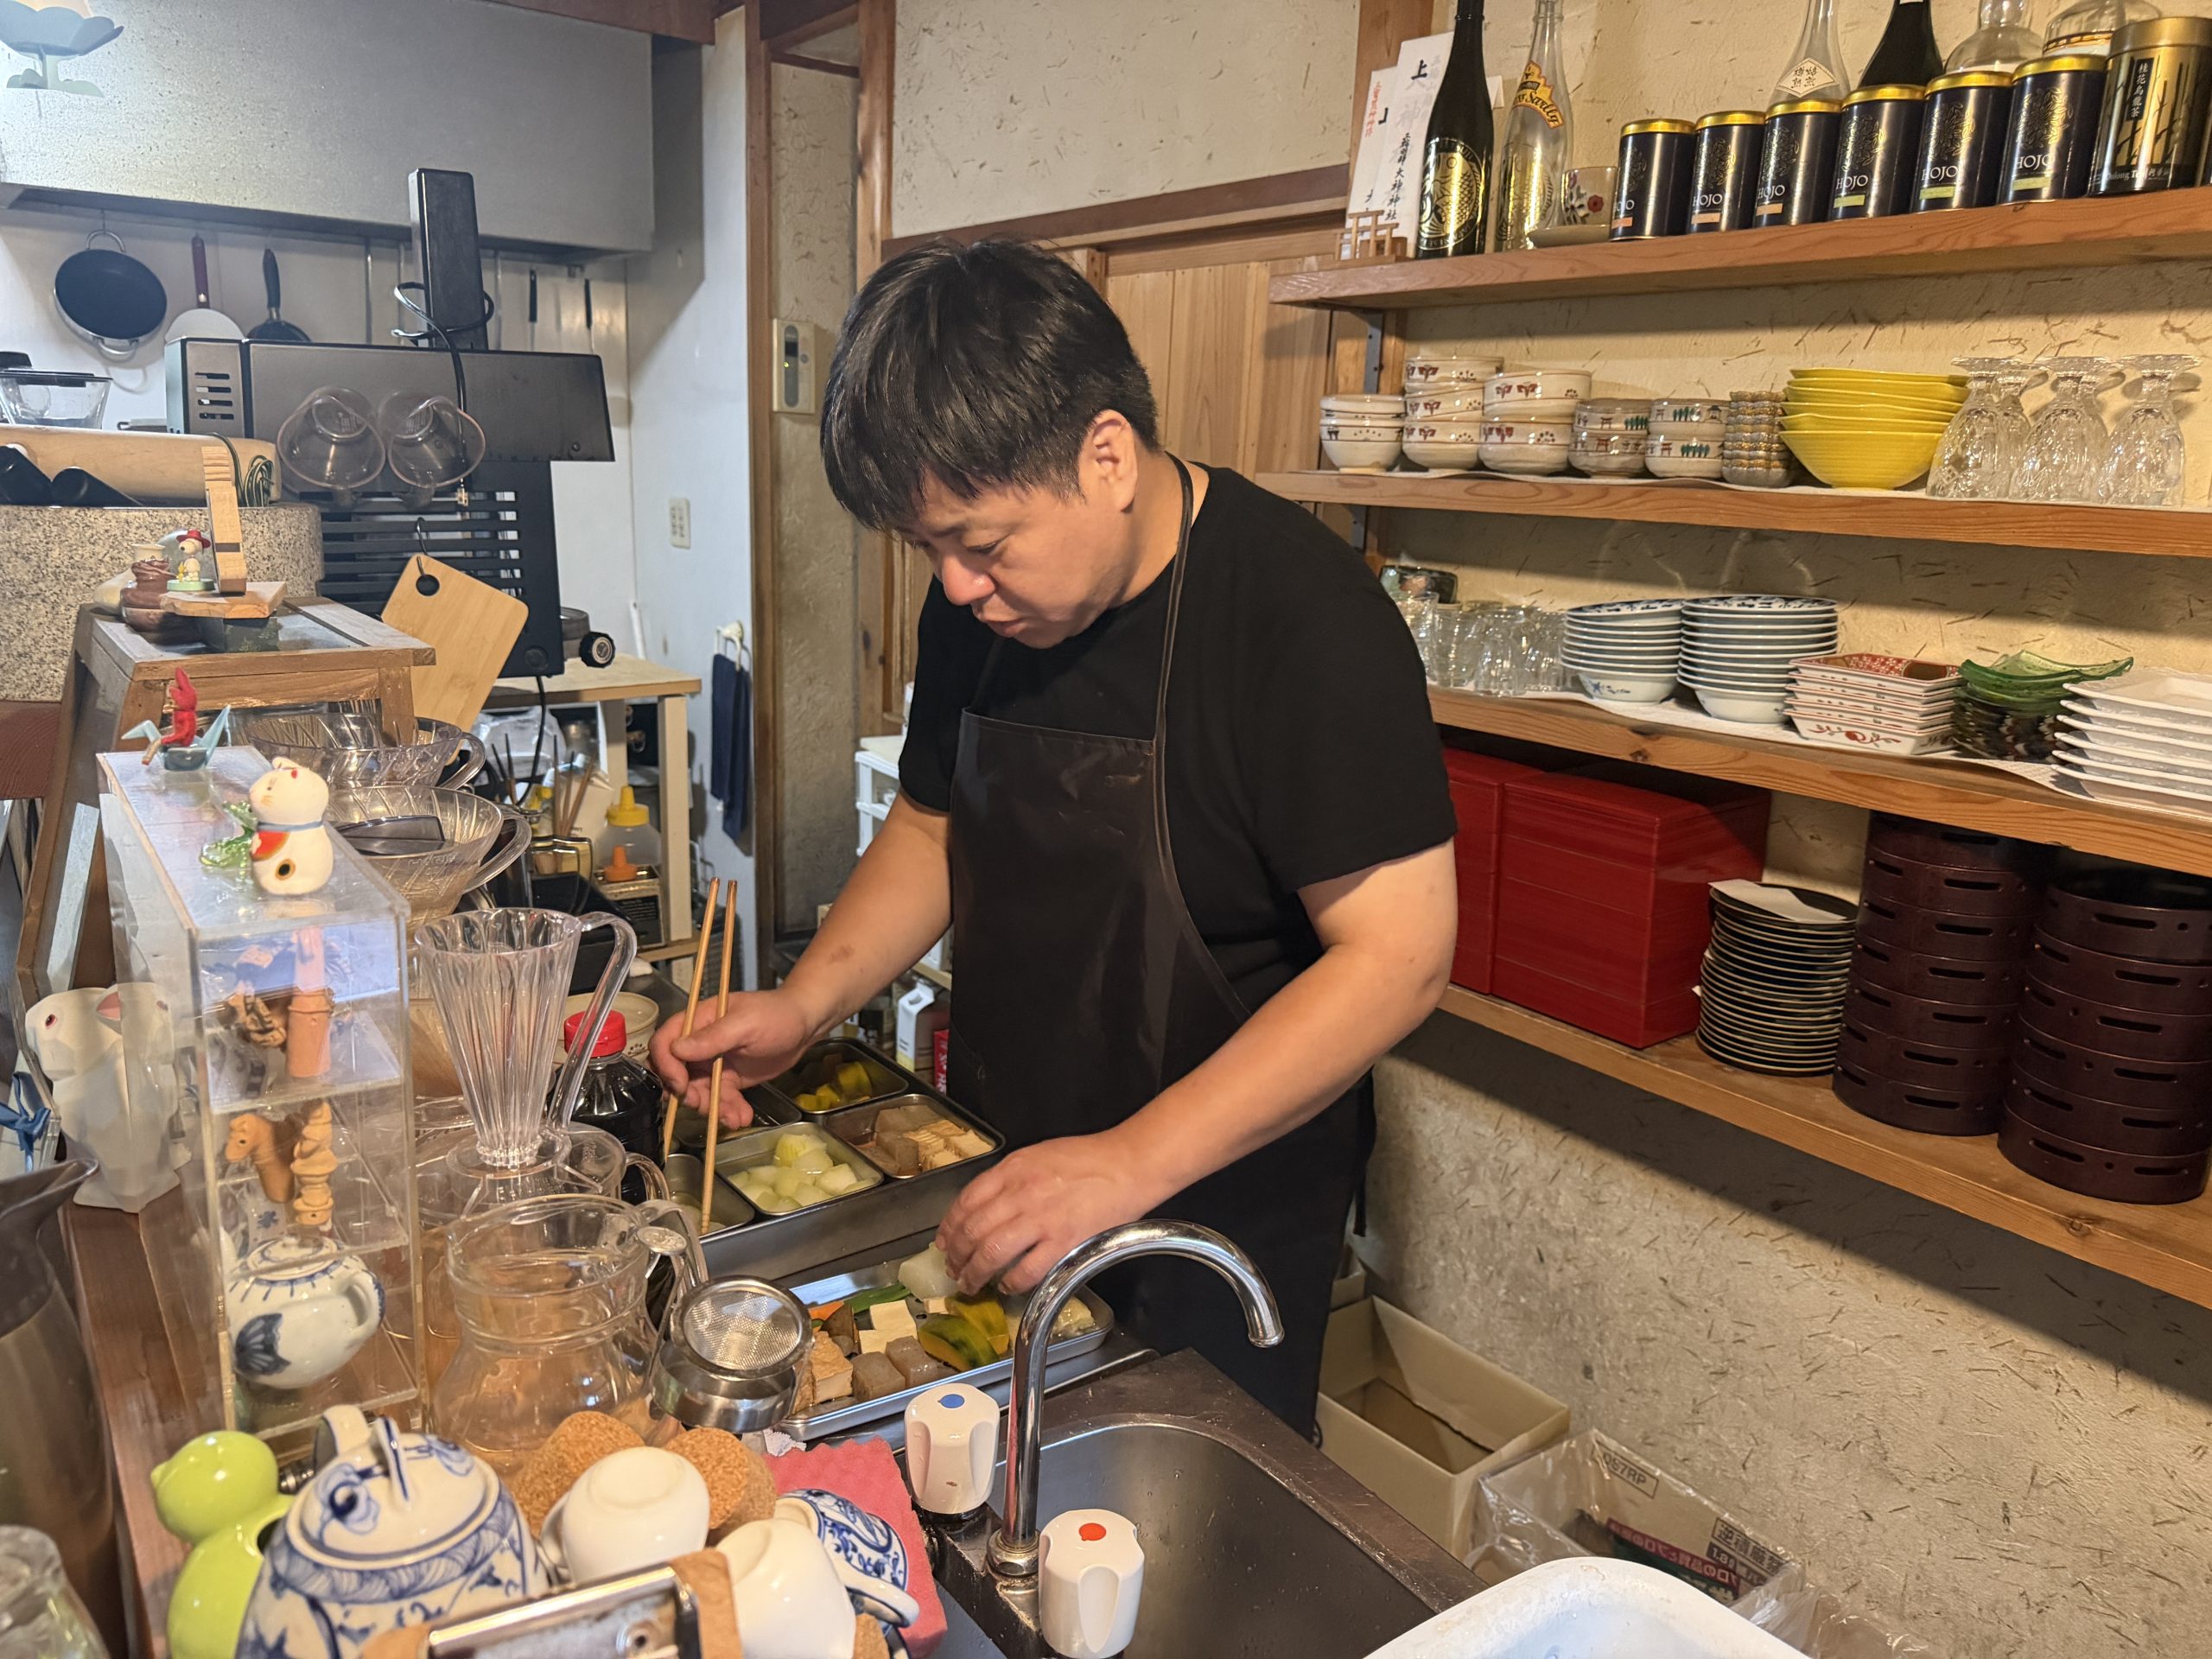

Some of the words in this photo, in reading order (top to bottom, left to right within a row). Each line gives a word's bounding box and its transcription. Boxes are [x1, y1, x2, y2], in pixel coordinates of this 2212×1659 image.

[1411, 59, 1427, 80] 上
[1921, 165, 1959, 181] HOJO
[1836, 175, 1869, 190] HOJO
[1758, 184, 1785, 200] HOJO
[1692, 194, 1723, 207] HOJO
